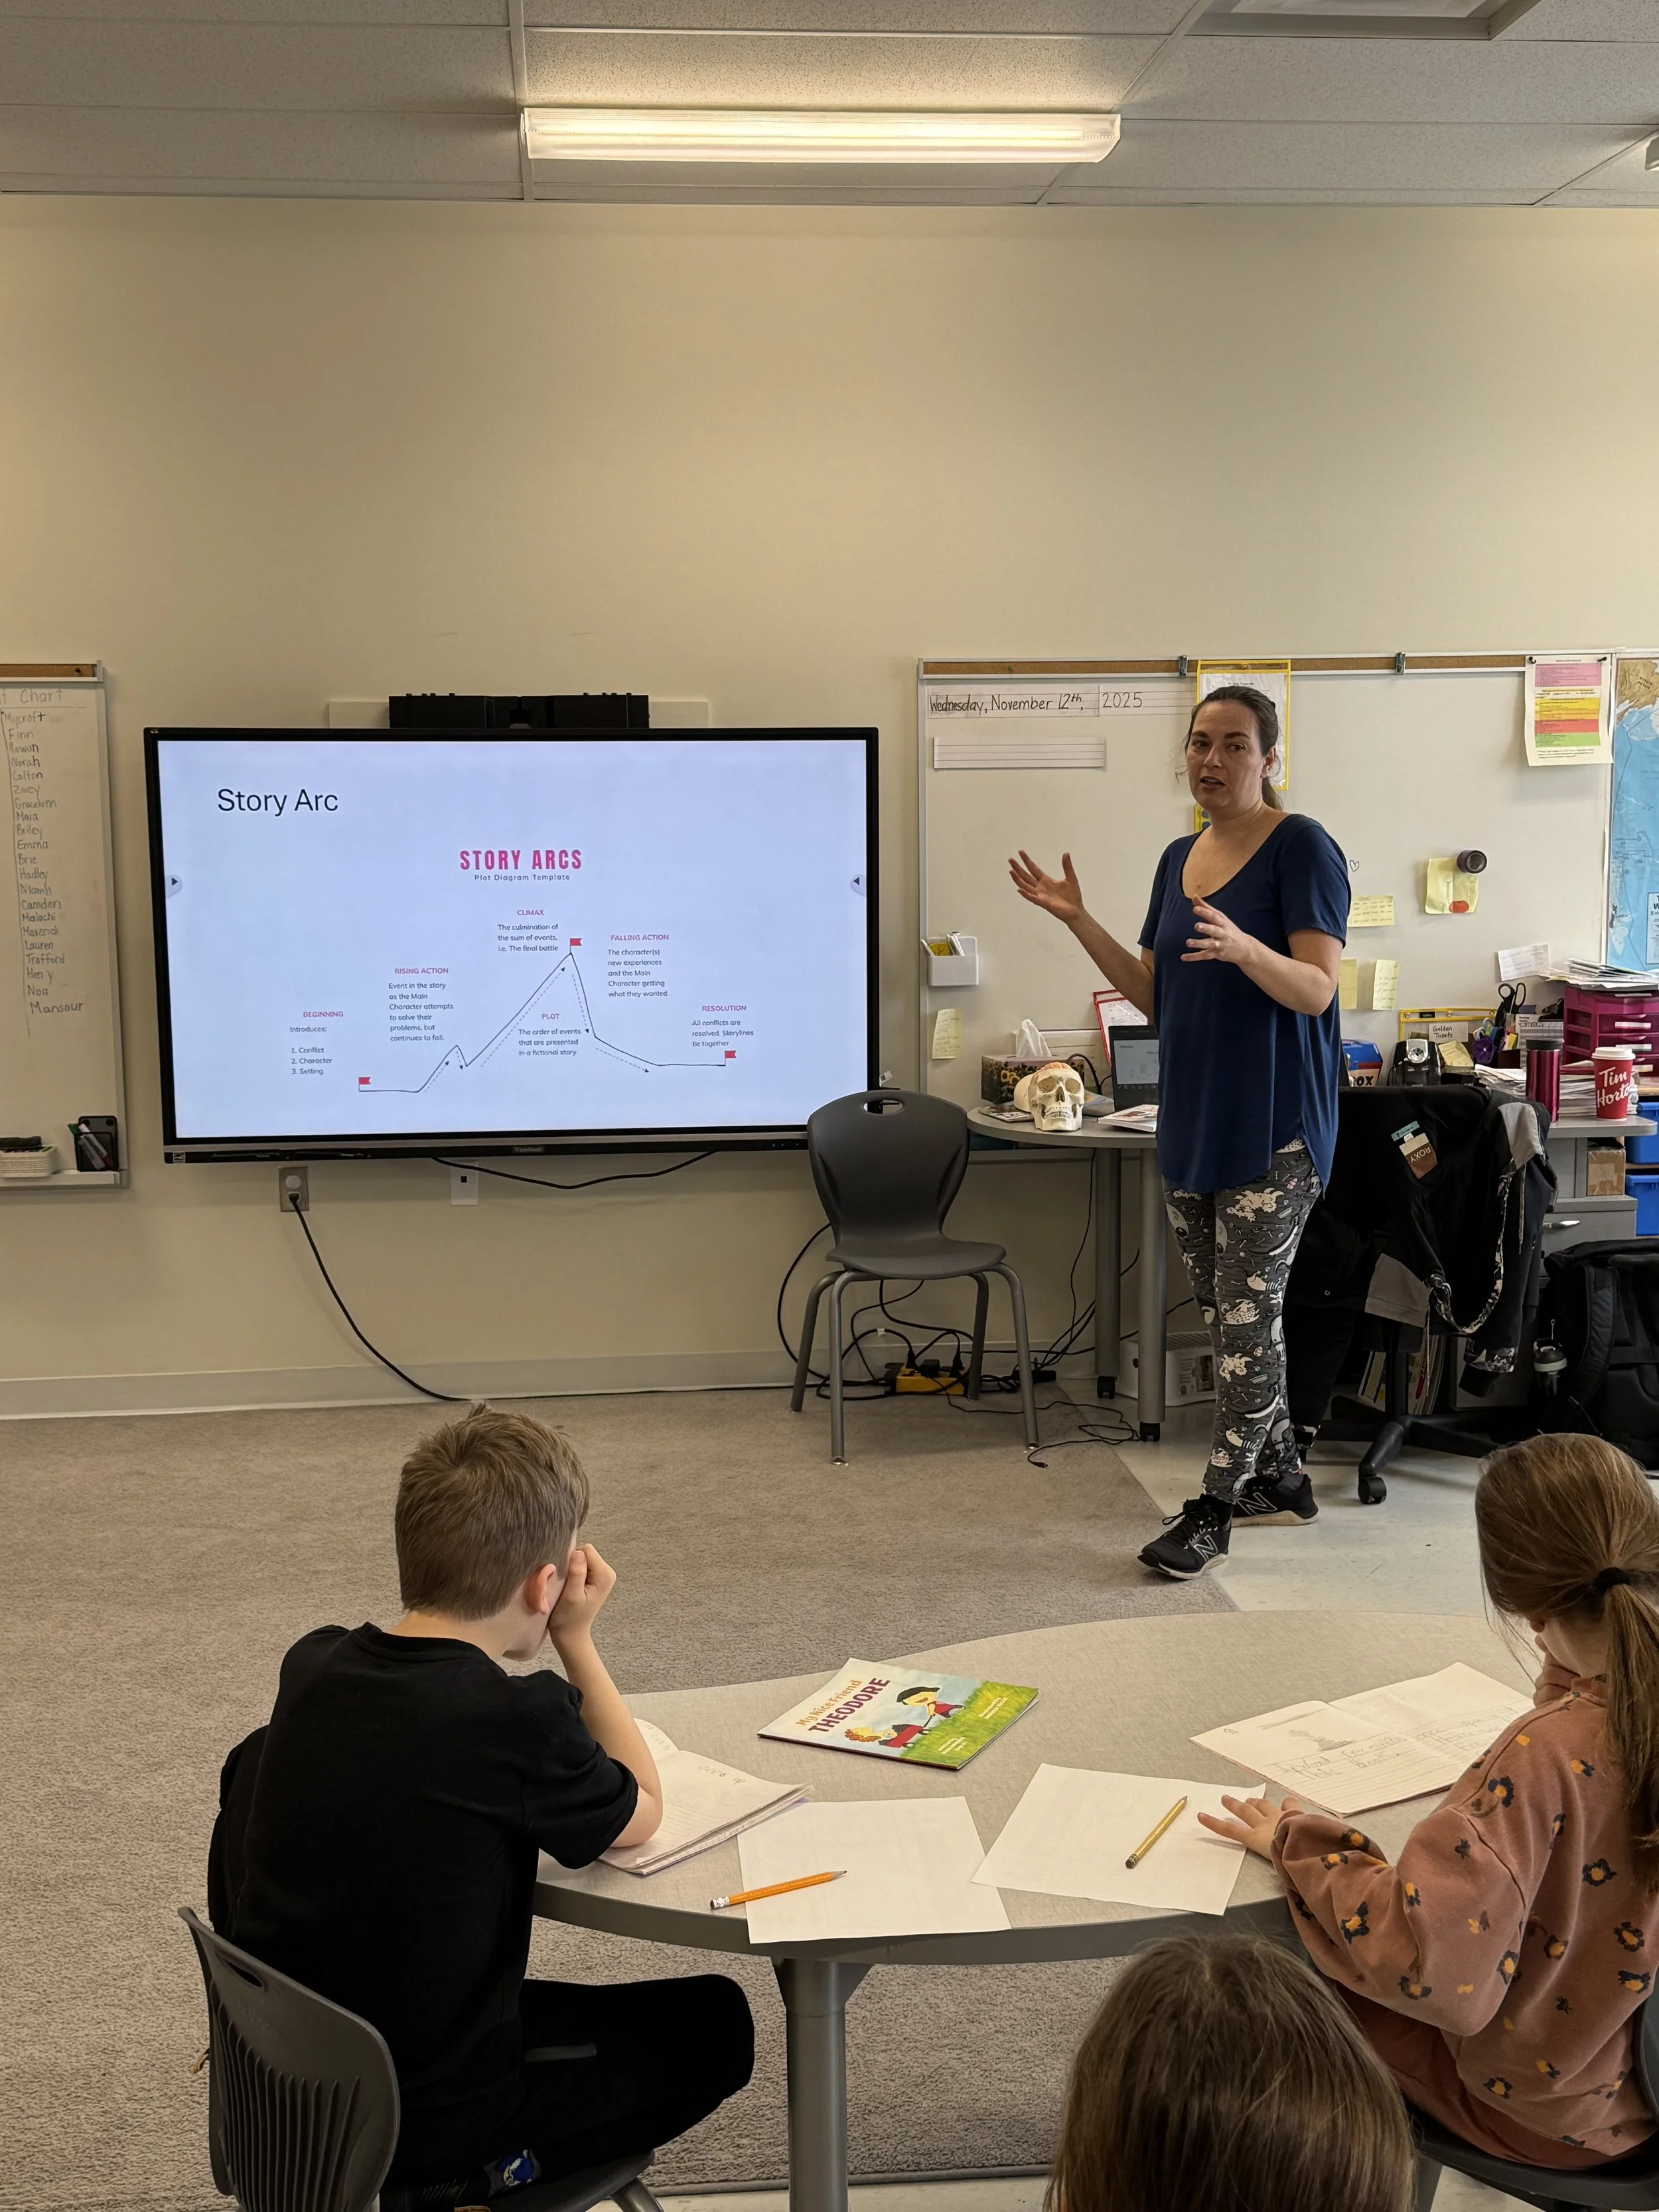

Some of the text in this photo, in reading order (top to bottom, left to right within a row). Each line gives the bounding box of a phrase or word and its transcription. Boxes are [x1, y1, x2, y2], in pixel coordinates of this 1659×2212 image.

[21, 686, 63, 703] Chart
[929, 694, 988, 716] Wednesday,
[991, 694, 1053, 711] November
[1103, 692, 1143, 708] 2025
[9, 728, 34, 740] Finn
[9, 742, 39, 753] Rowan
[11, 755, 40, 768] Norah
[13, 770, 43, 780] Colton
[13, 784, 40, 801] Zoey
[218, 788, 338, 817] Story Arc
[17, 840, 48, 849] Emma
[19, 853, 37, 865] Brie
[460, 849, 581, 870] STORY ARCS
[21, 897, 62, 910] Camden
[25, 940, 54, 950] Lauren
[27, 985, 48, 996] Noa
[30, 1001, 84, 1014] Mansour
[1354, 1075, 1374, 1086] OX
[1599, 1067, 1628, 1087] Tim
[1409, 1146, 1431, 1163] ROXY
[795, 1680, 863, 1726] My Nice Friend
[808, 1678, 891, 1732] THEODORE
